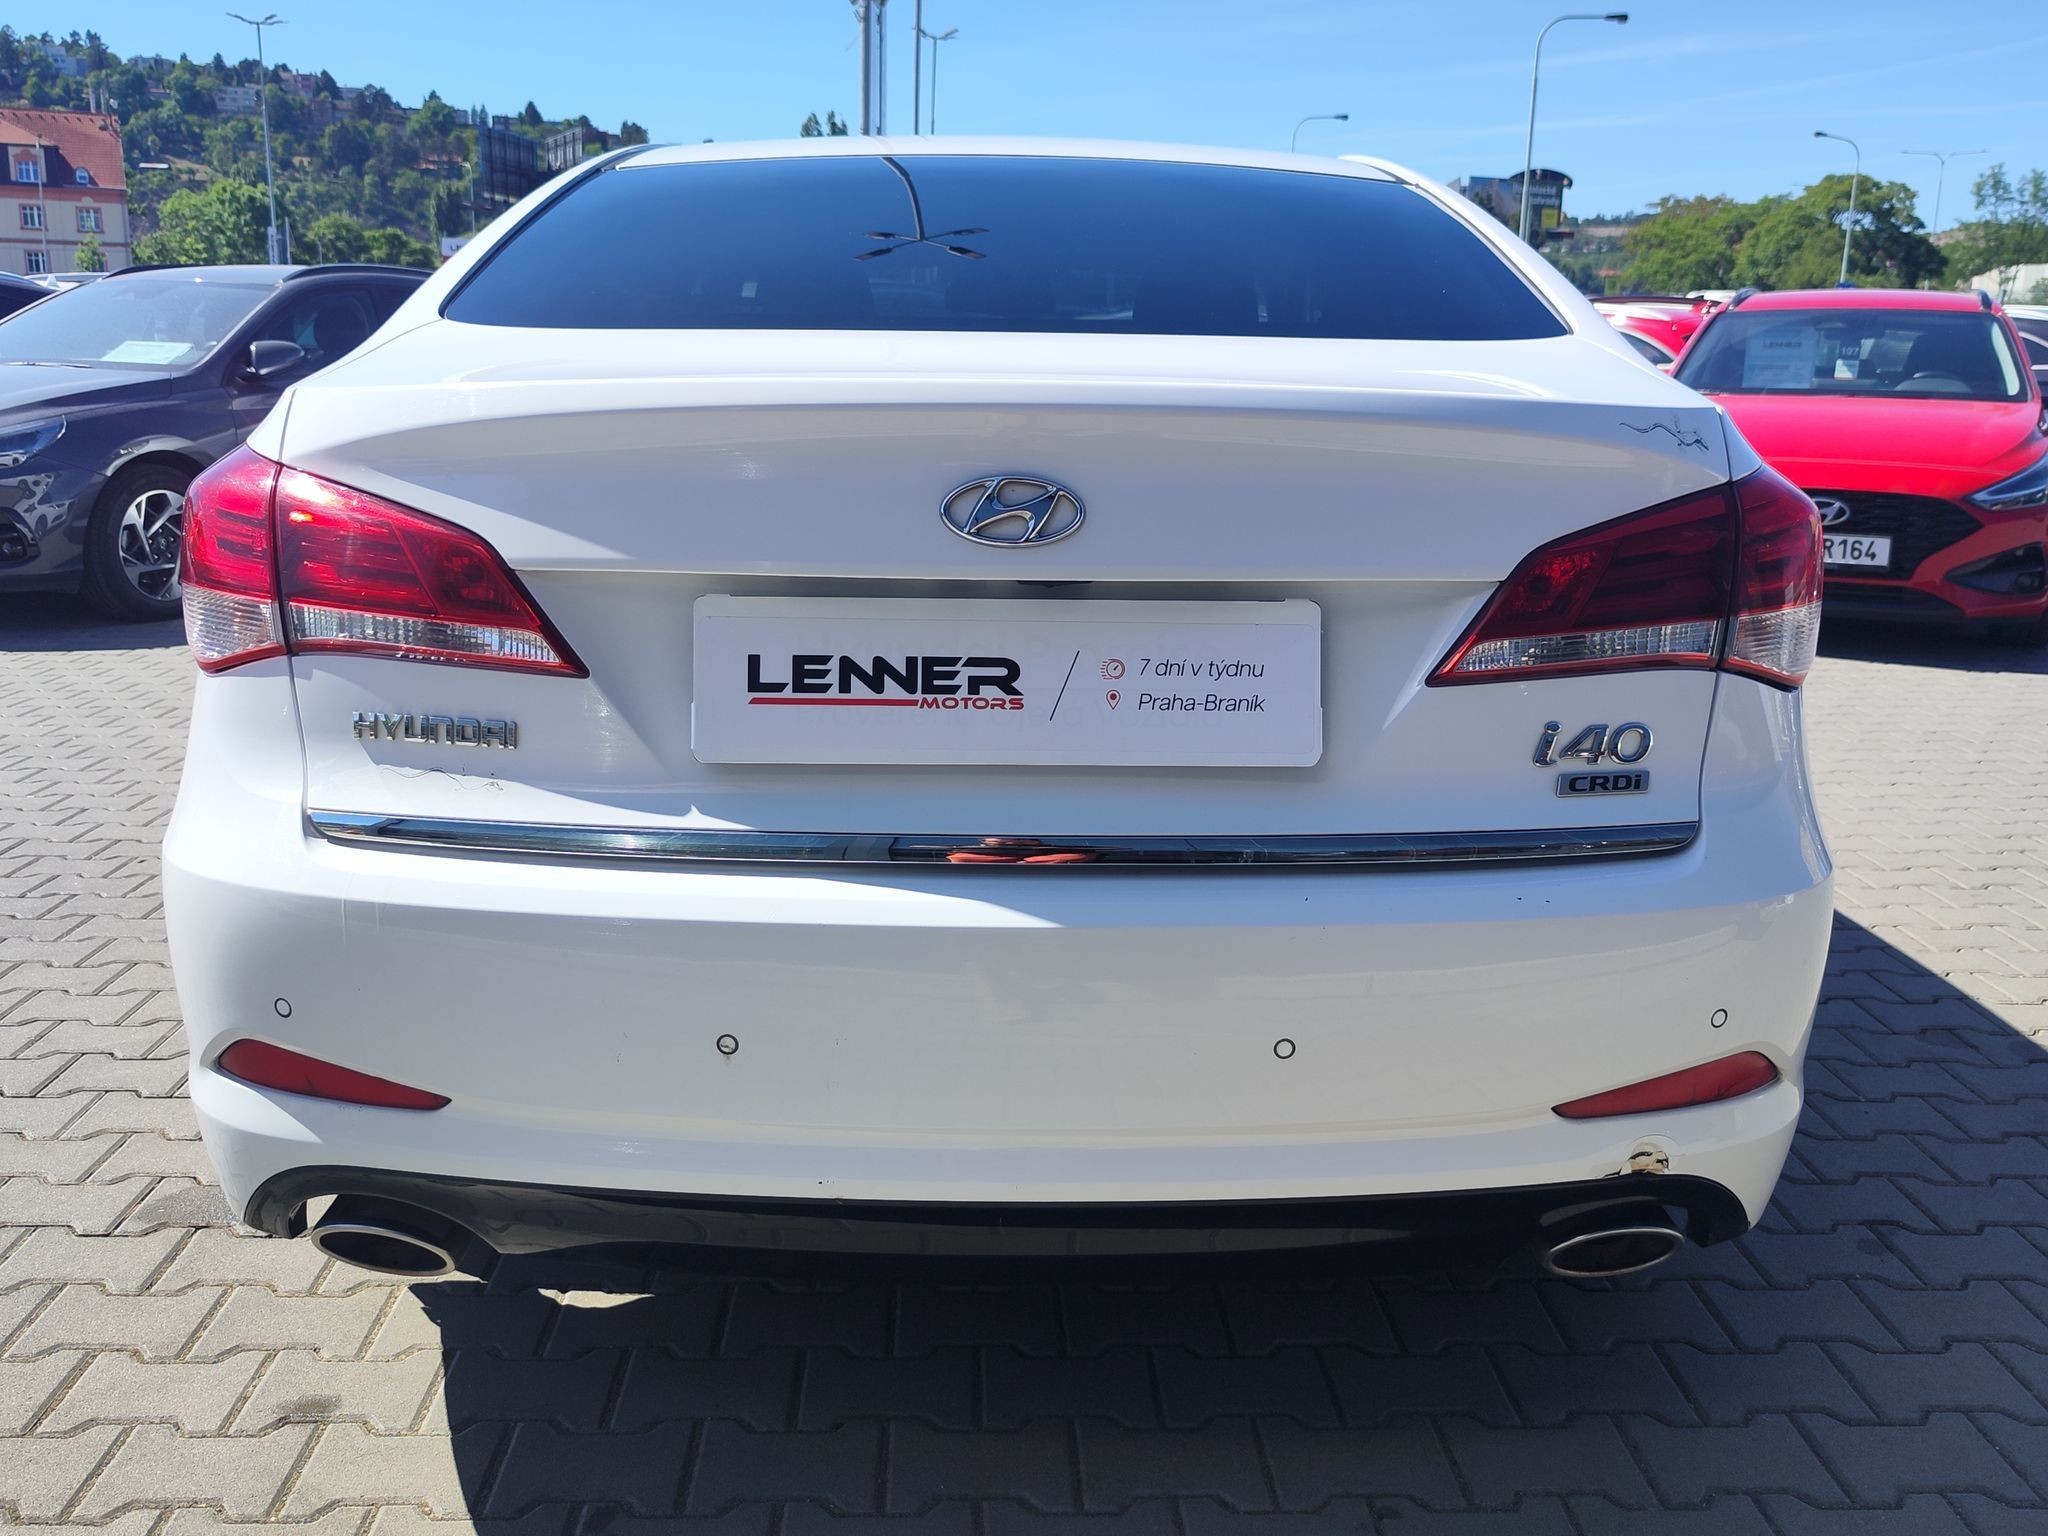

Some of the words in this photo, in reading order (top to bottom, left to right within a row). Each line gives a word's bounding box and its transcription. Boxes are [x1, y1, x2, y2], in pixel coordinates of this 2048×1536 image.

[747, 654, 1024, 696] LENNER
[1139, 658, 1151, 676] 7
[1155, 658, 1187, 677] dní
[1190, 663, 1203, 677] v
[1208, 659, 1265, 682] týdnu
[919, 697, 1025, 711] MOTORS
[1138, 693, 1266, 712] Praha-Braník
[352, 711, 518, 750] HYUNDAI
[1532, 720, 1654, 767] i40
[1568, 774, 1642, 793] CRDi
